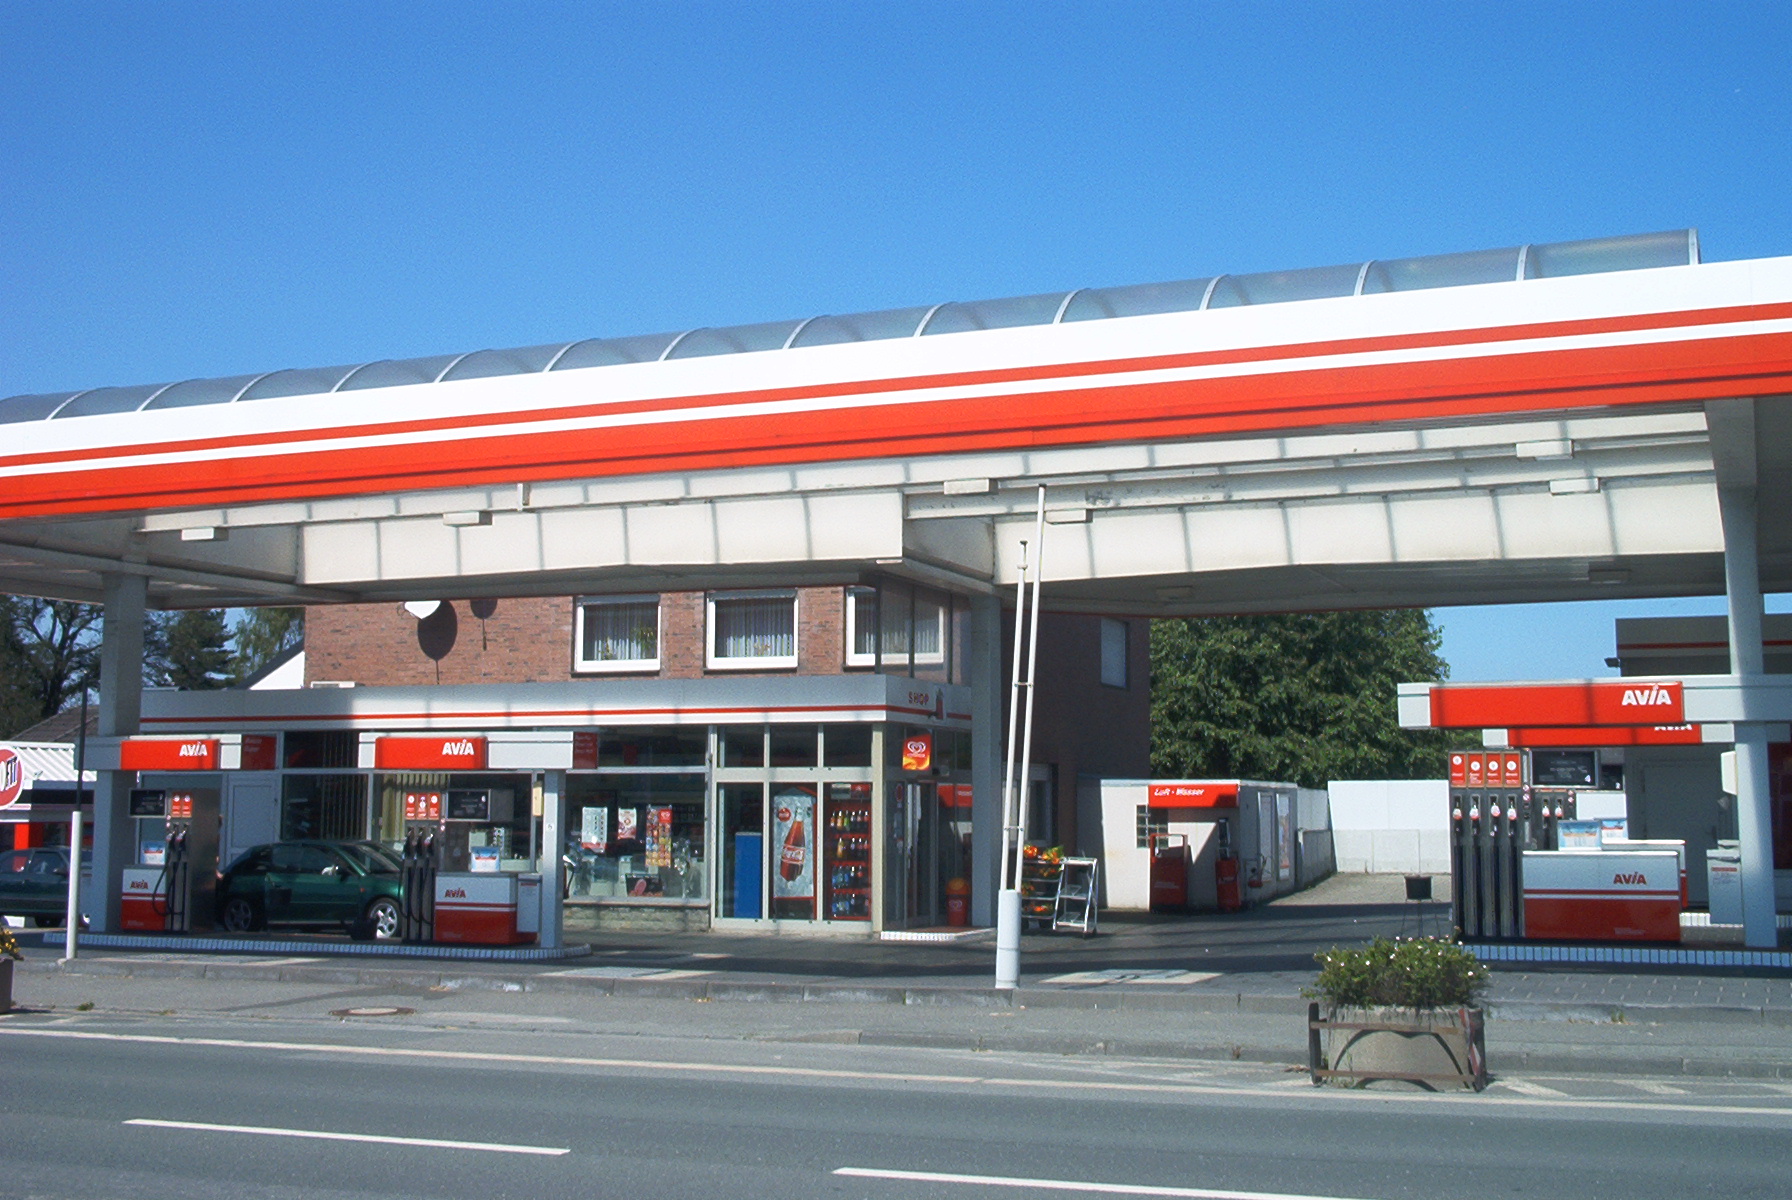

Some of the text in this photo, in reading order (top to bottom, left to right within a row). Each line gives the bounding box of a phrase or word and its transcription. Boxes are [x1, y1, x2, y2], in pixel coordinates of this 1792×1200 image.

[908, 691, 929, 705] SHOP
[1621, 683, 1672, 706] AVIA
[179, 741, 208, 756] AVIA
[442, 738, 474, 755] AVIA
[1613, 871, 1647, 885] AVIA
[444, 887, 466, 898] AVIA
